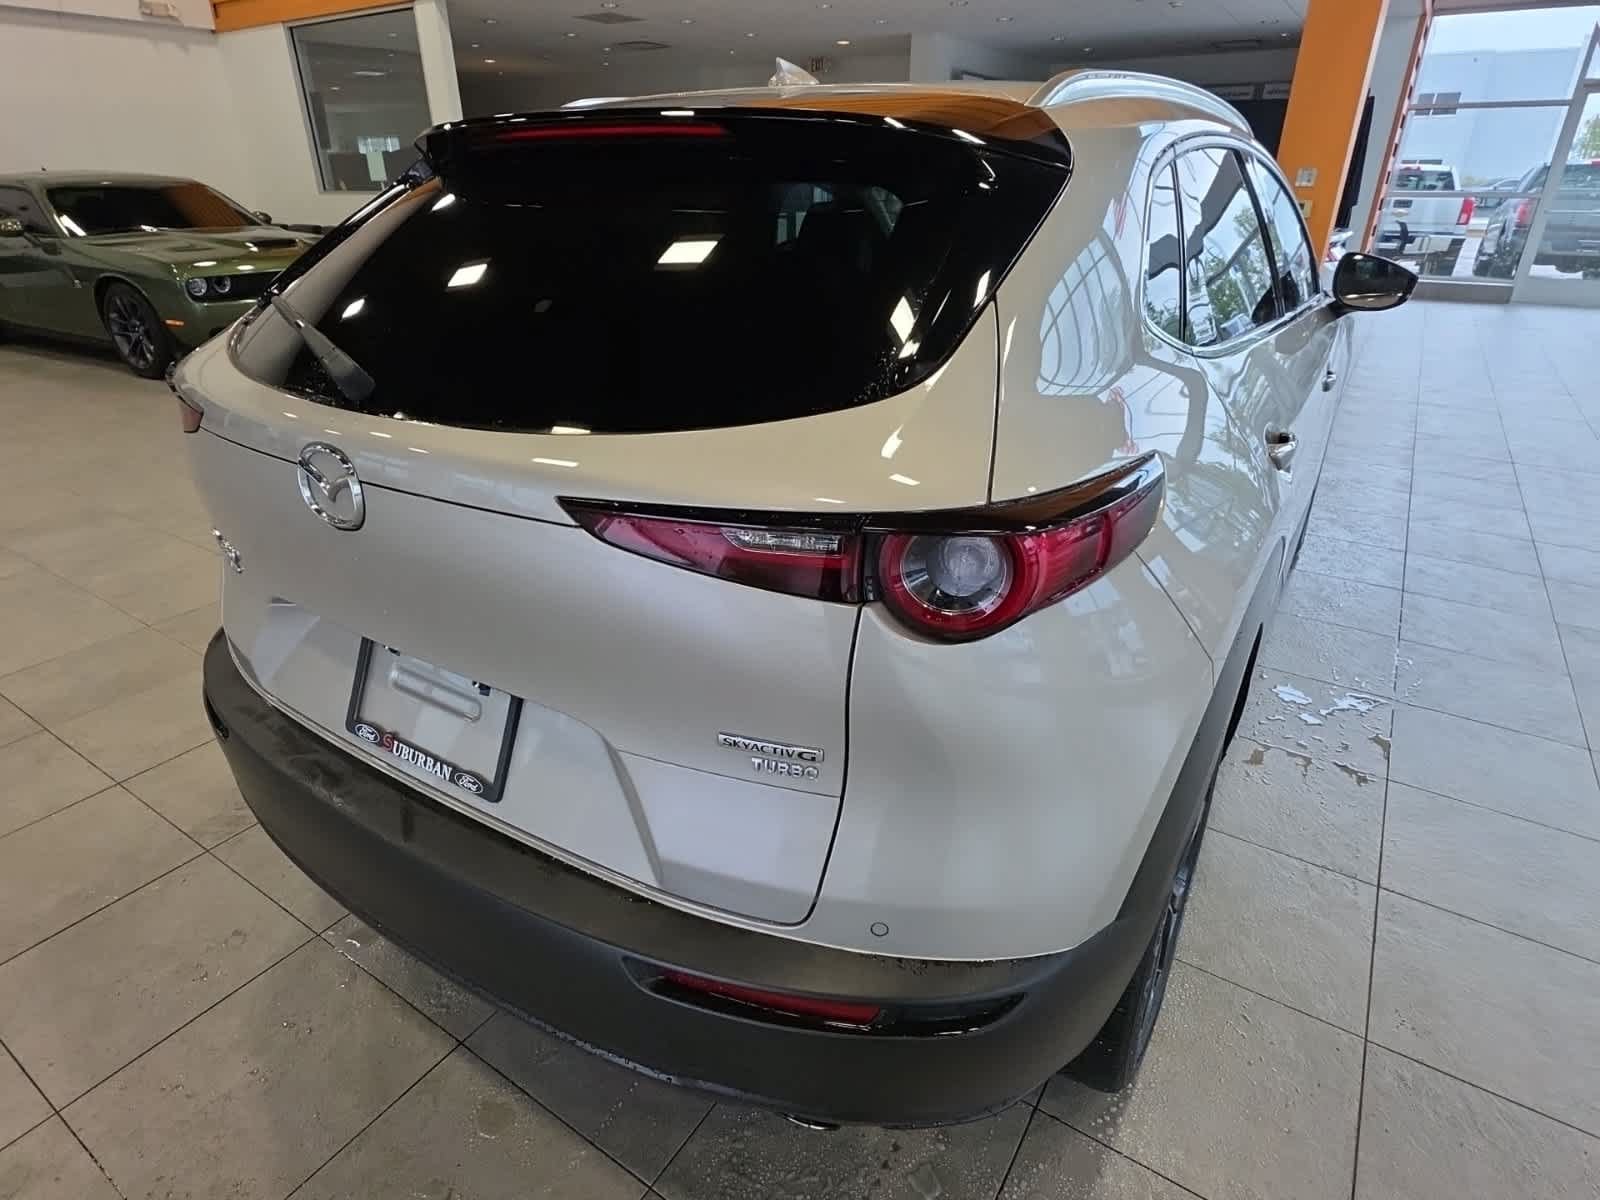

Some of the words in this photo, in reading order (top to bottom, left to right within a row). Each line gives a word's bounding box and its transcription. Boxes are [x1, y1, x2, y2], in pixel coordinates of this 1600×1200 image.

[358, 724, 377, 741] Ford
[382, 732, 453, 781] SUBURBAN
[458, 774, 480, 793] Ford
[751, 757, 819, 780] TURBO
